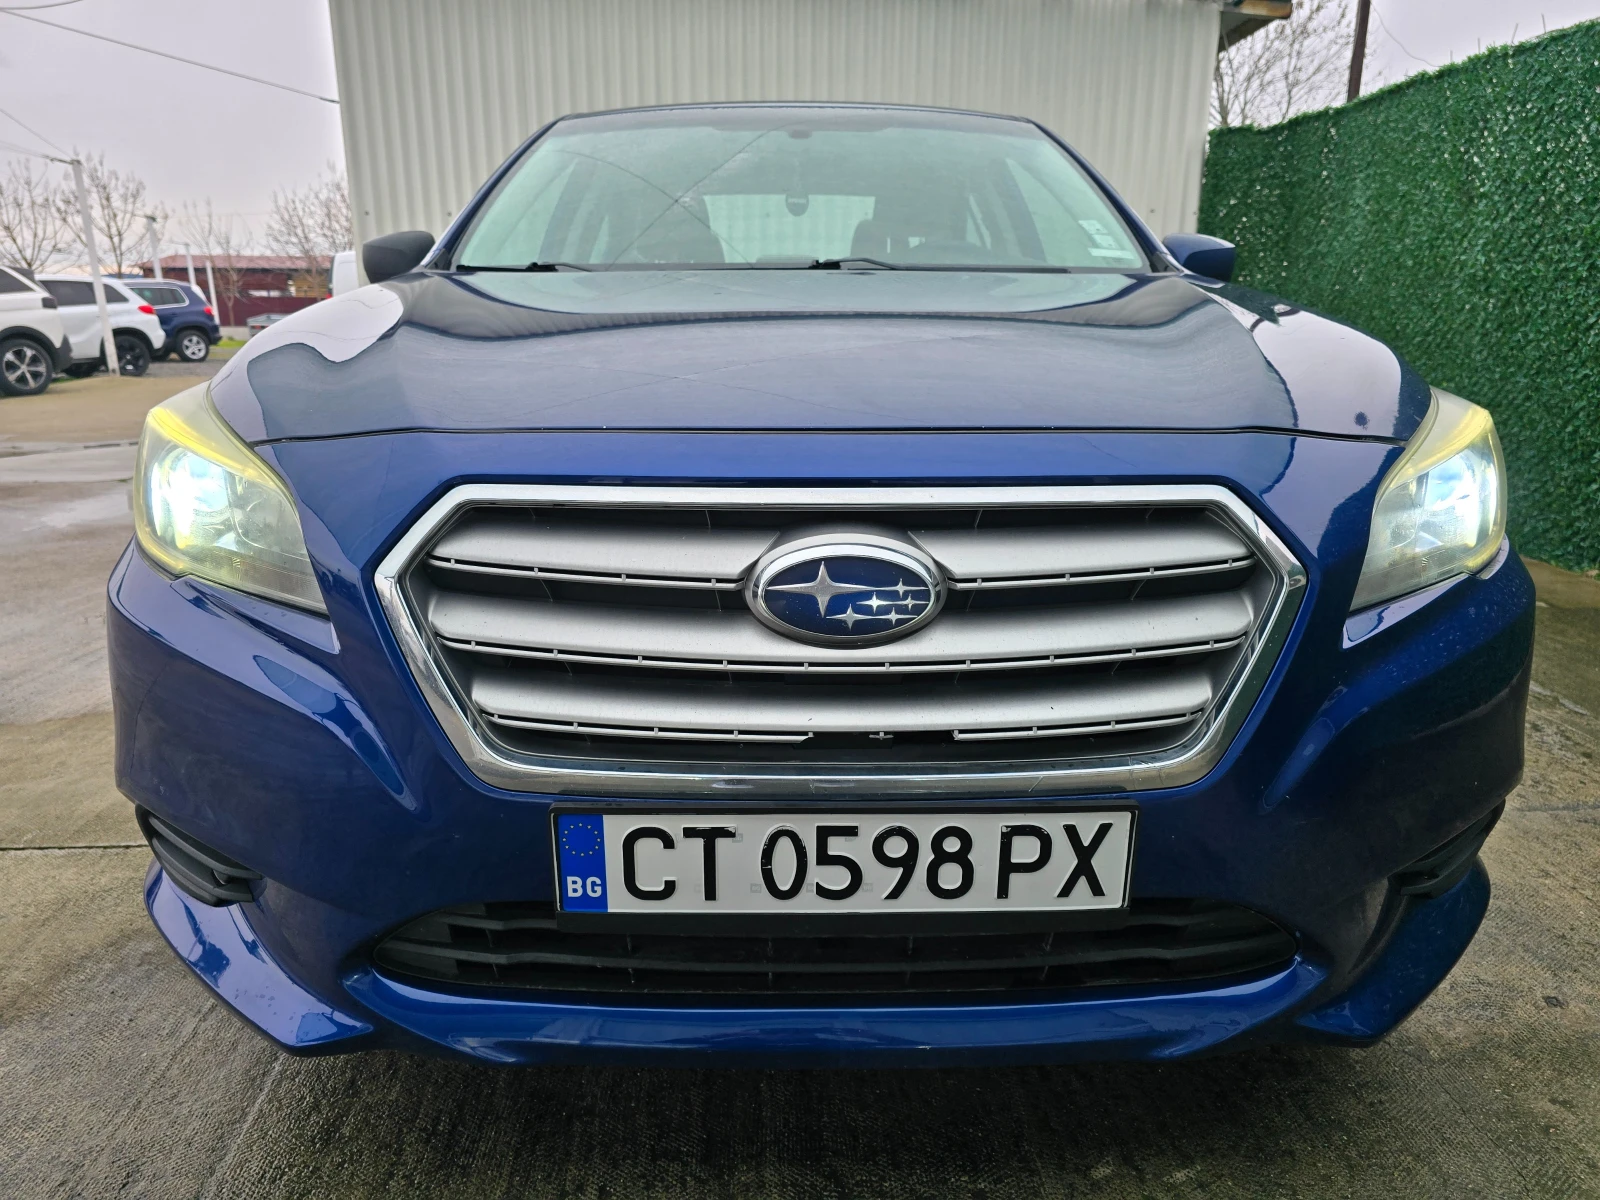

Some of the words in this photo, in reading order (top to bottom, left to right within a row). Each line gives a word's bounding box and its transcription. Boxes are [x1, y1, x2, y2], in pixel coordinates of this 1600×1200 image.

[622, 826, 737, 901] CT
[760, 825, 975, 901] 0598
[996, 822, 1114, 900] PX
[566, 876, 602, 898] BG
